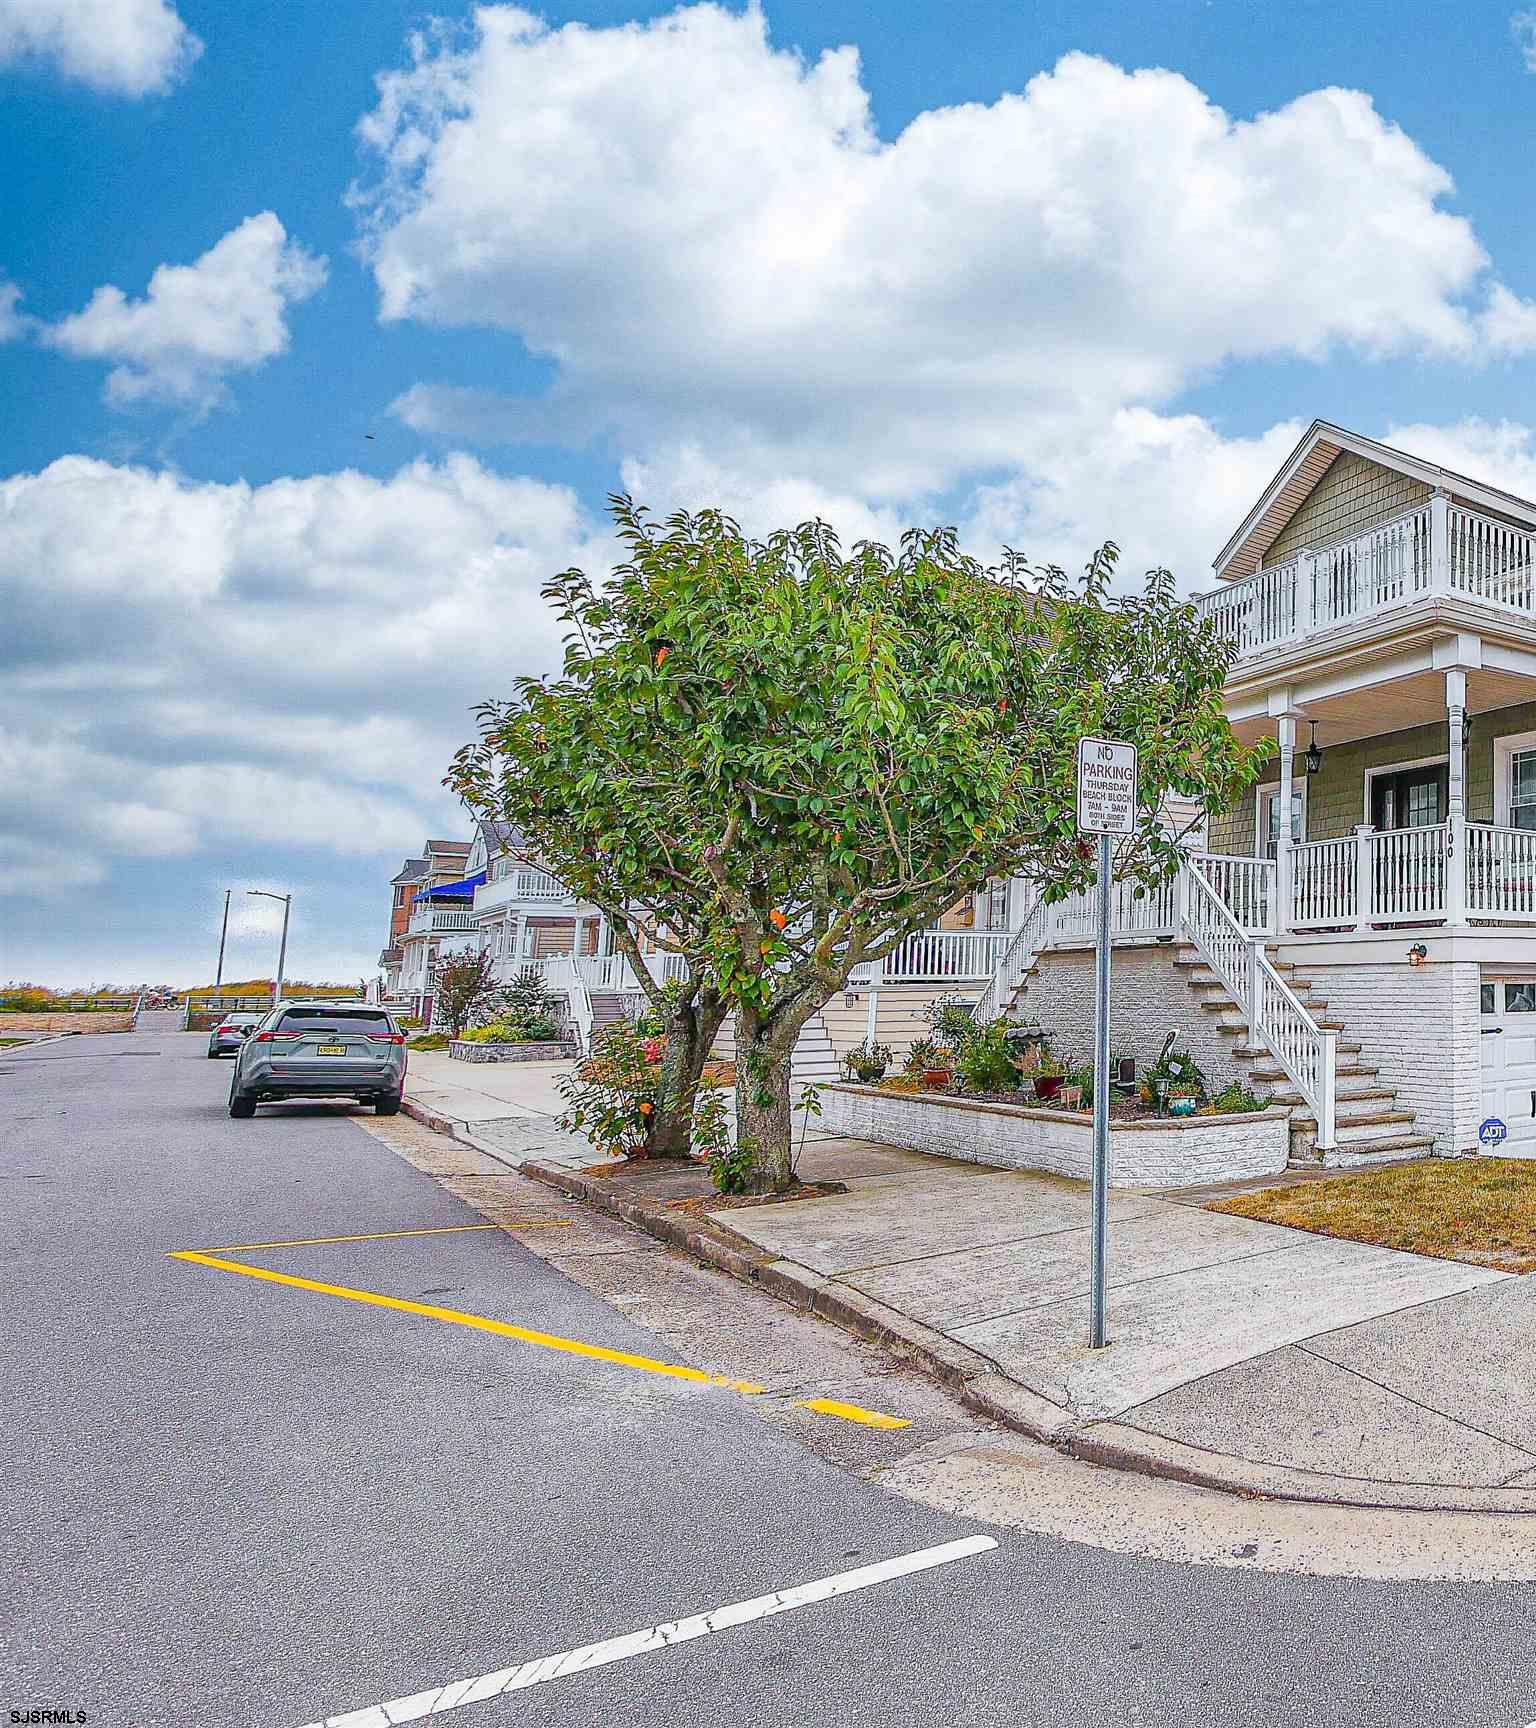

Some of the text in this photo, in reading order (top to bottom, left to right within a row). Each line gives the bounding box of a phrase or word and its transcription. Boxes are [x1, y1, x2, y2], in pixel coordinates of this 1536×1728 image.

[1097, 746, 1114, 760] NO
[1083, 762, 1132, 780] PARKING
[1087, 780, 1129, 792] THURSDAY
[1082, 790, 1132, 803] BEACH BLOCK
[1088, 801, 1102, 811] 7AM
[1112, 804, 1128, 813] 9AM
[1088, 811, 1126, 821] BOTH SIDES
[1481, 1126, 1504, 1138] ADT
